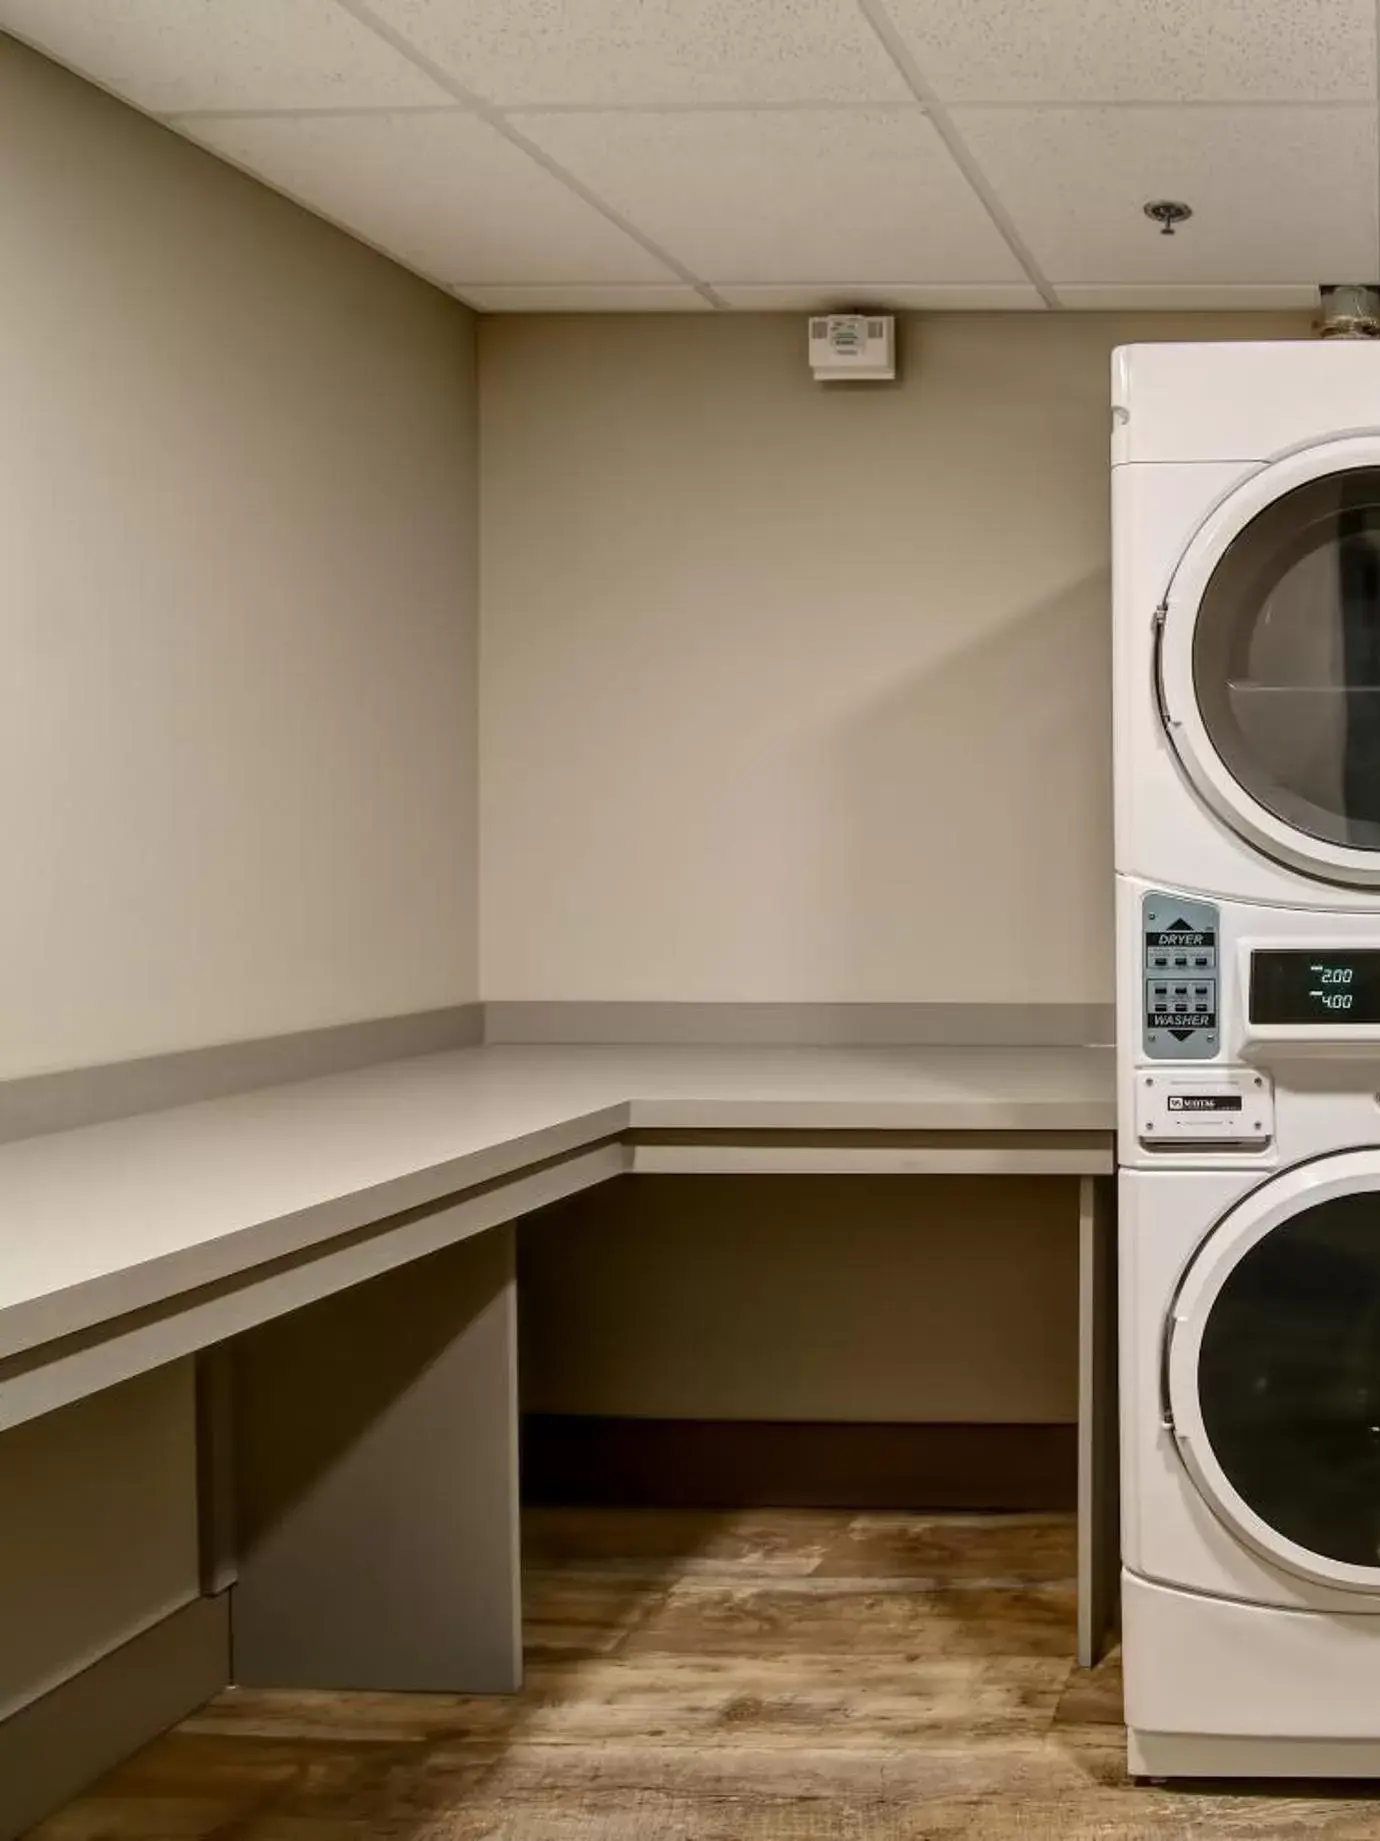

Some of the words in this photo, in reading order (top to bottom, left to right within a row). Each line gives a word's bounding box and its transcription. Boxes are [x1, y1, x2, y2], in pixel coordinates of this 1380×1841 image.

[1158, 934, 1204, 945] DRYER
[1321, 968, 1353, 983] 2.00
[1321, 994, 1353, 1009] 4.00
[1154, 1014, 1209, 1026] WASHER
